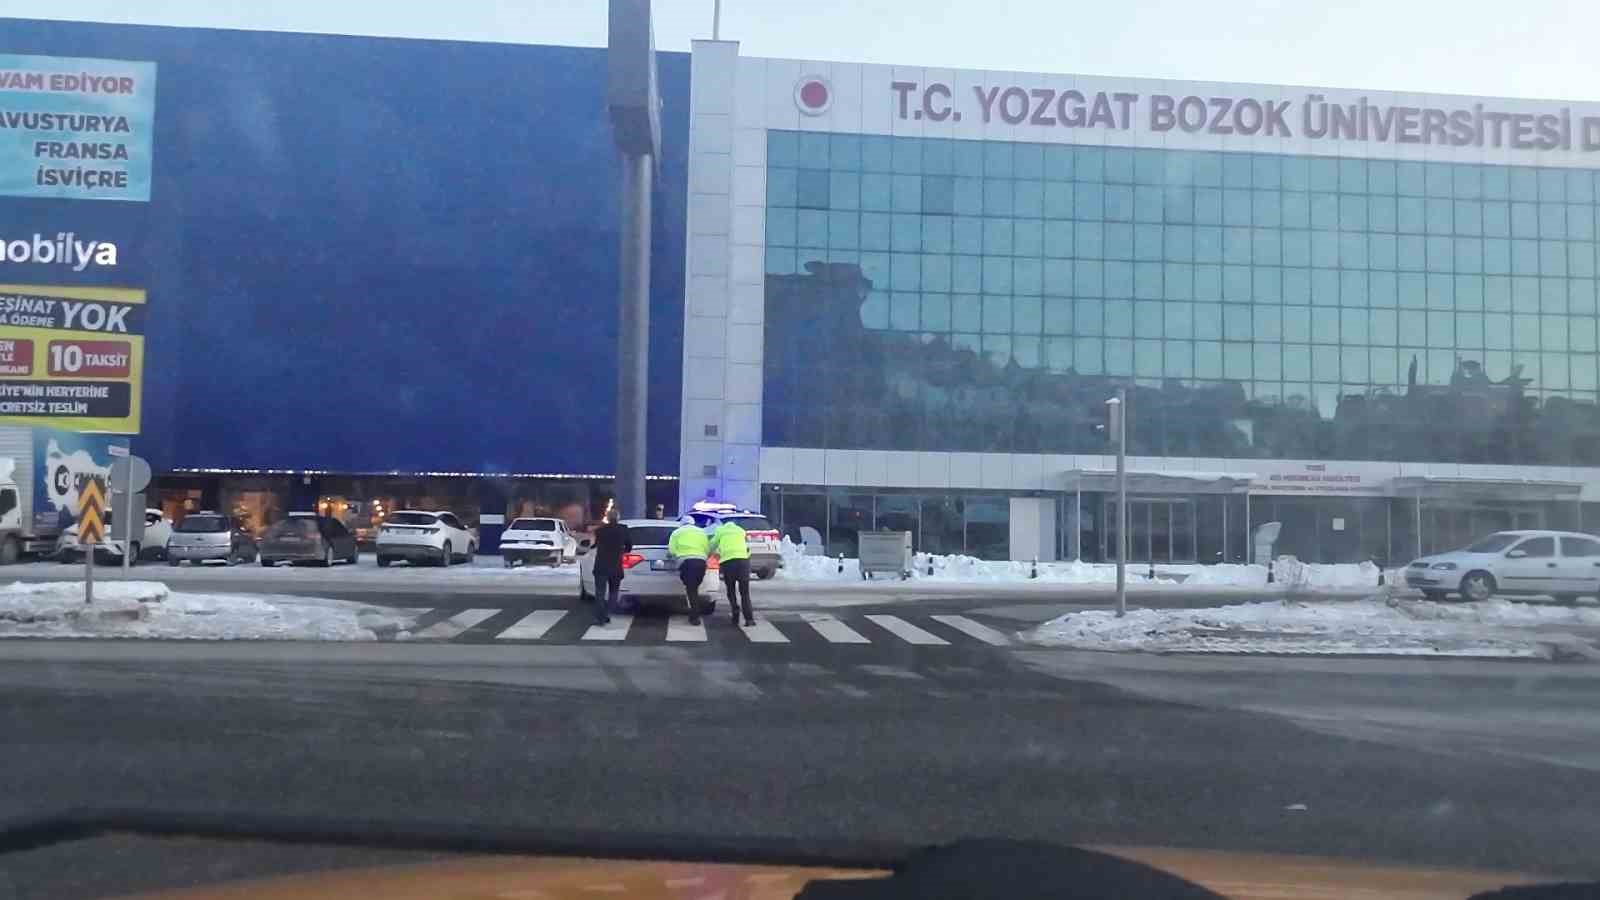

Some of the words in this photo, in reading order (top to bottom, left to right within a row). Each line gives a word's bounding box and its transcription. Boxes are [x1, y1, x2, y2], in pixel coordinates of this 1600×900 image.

[50, 72, 134, 94] EDİYOR
[0, 111, 130, 133] AVUSTURYA
[891, 81, 961, 122] T.C.
[973, 86, 1138, 130] YOZGAT
[1151, 95, 1292, 138] BOZOK
[1302, 94, 1571, 151] ÜNİVERSİTESİ
[34, 141, 129, 160] FRANSA
[36, 165, 128, 190] İSVİÇRE
[61, 301, 132, 332] YOK
[51, 344, 82, 372] 10
[85, 352, 128, 367] TAKSİT
[48, 401, 88, 414] TESLİM
